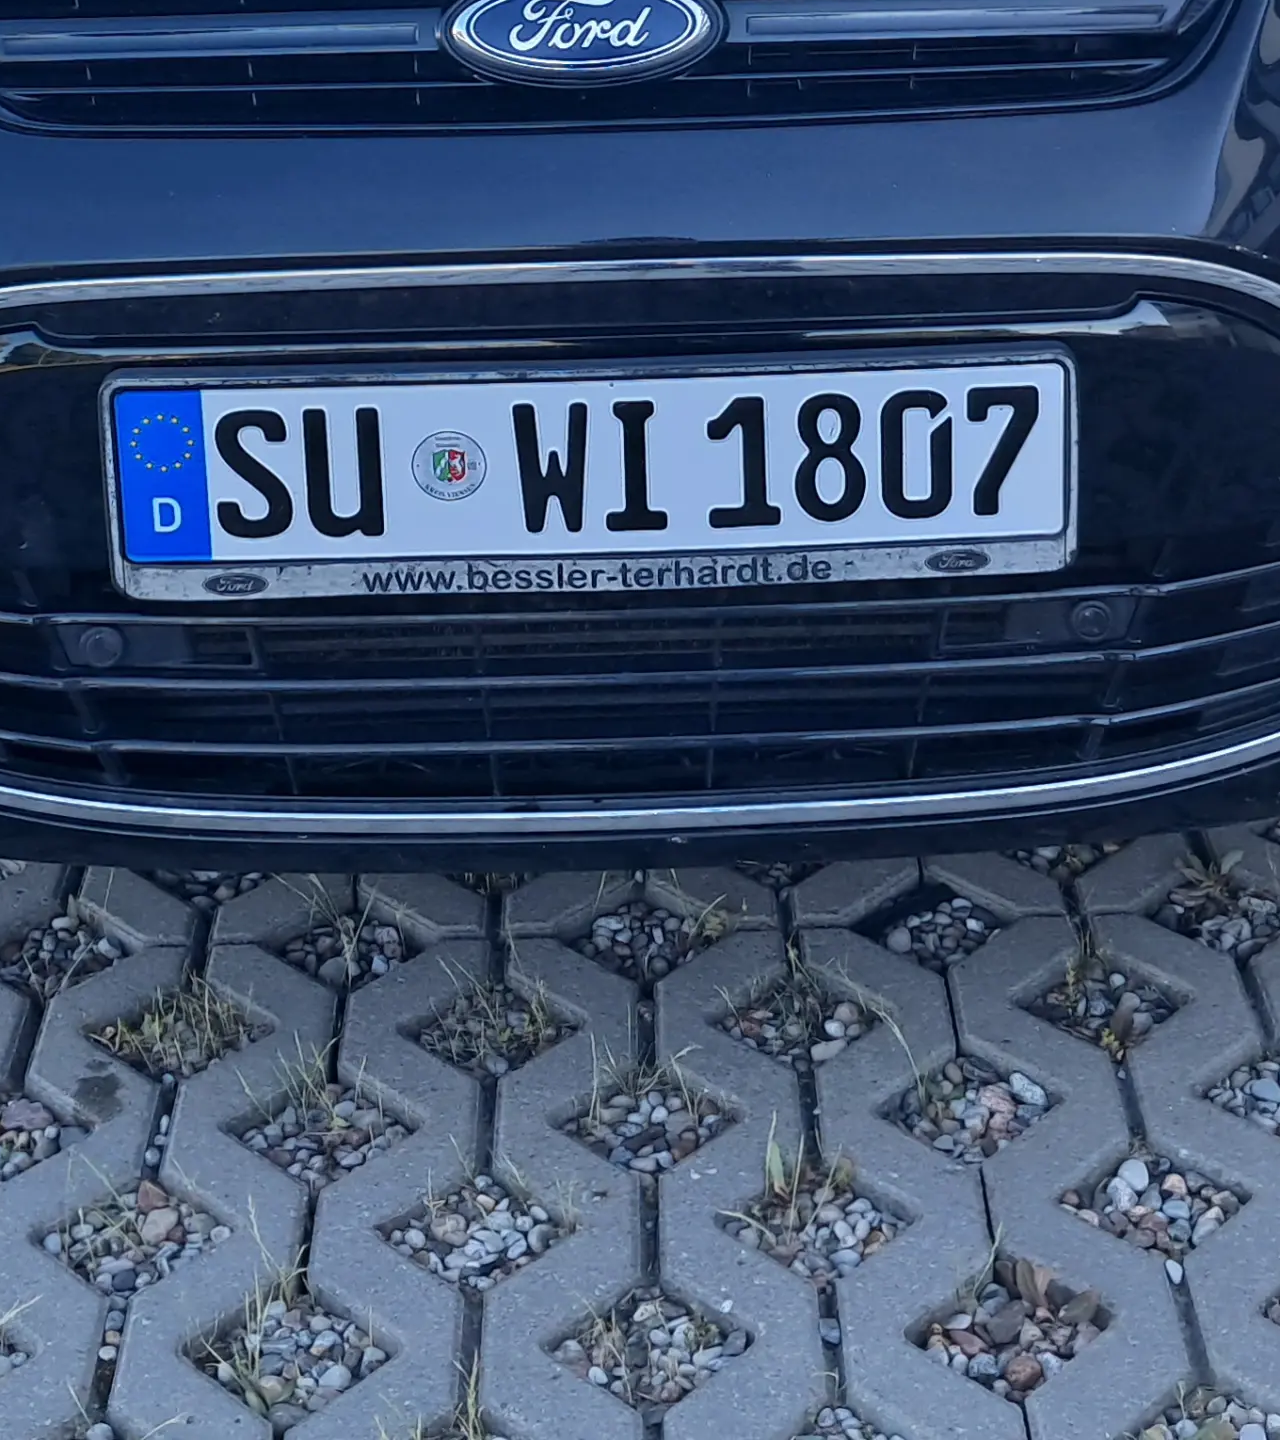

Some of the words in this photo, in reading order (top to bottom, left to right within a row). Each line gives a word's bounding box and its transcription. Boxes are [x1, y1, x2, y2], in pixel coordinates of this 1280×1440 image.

[214, 406, 385, 539] SU
[512, 399, 668, 533] WI
[706, 385, 1040, 529] 1807
[152, 497, 182, 533] D
[216, 576, 254, 592] Ford
[362, 554, 833, 594] www.bessler-terhardt.de
